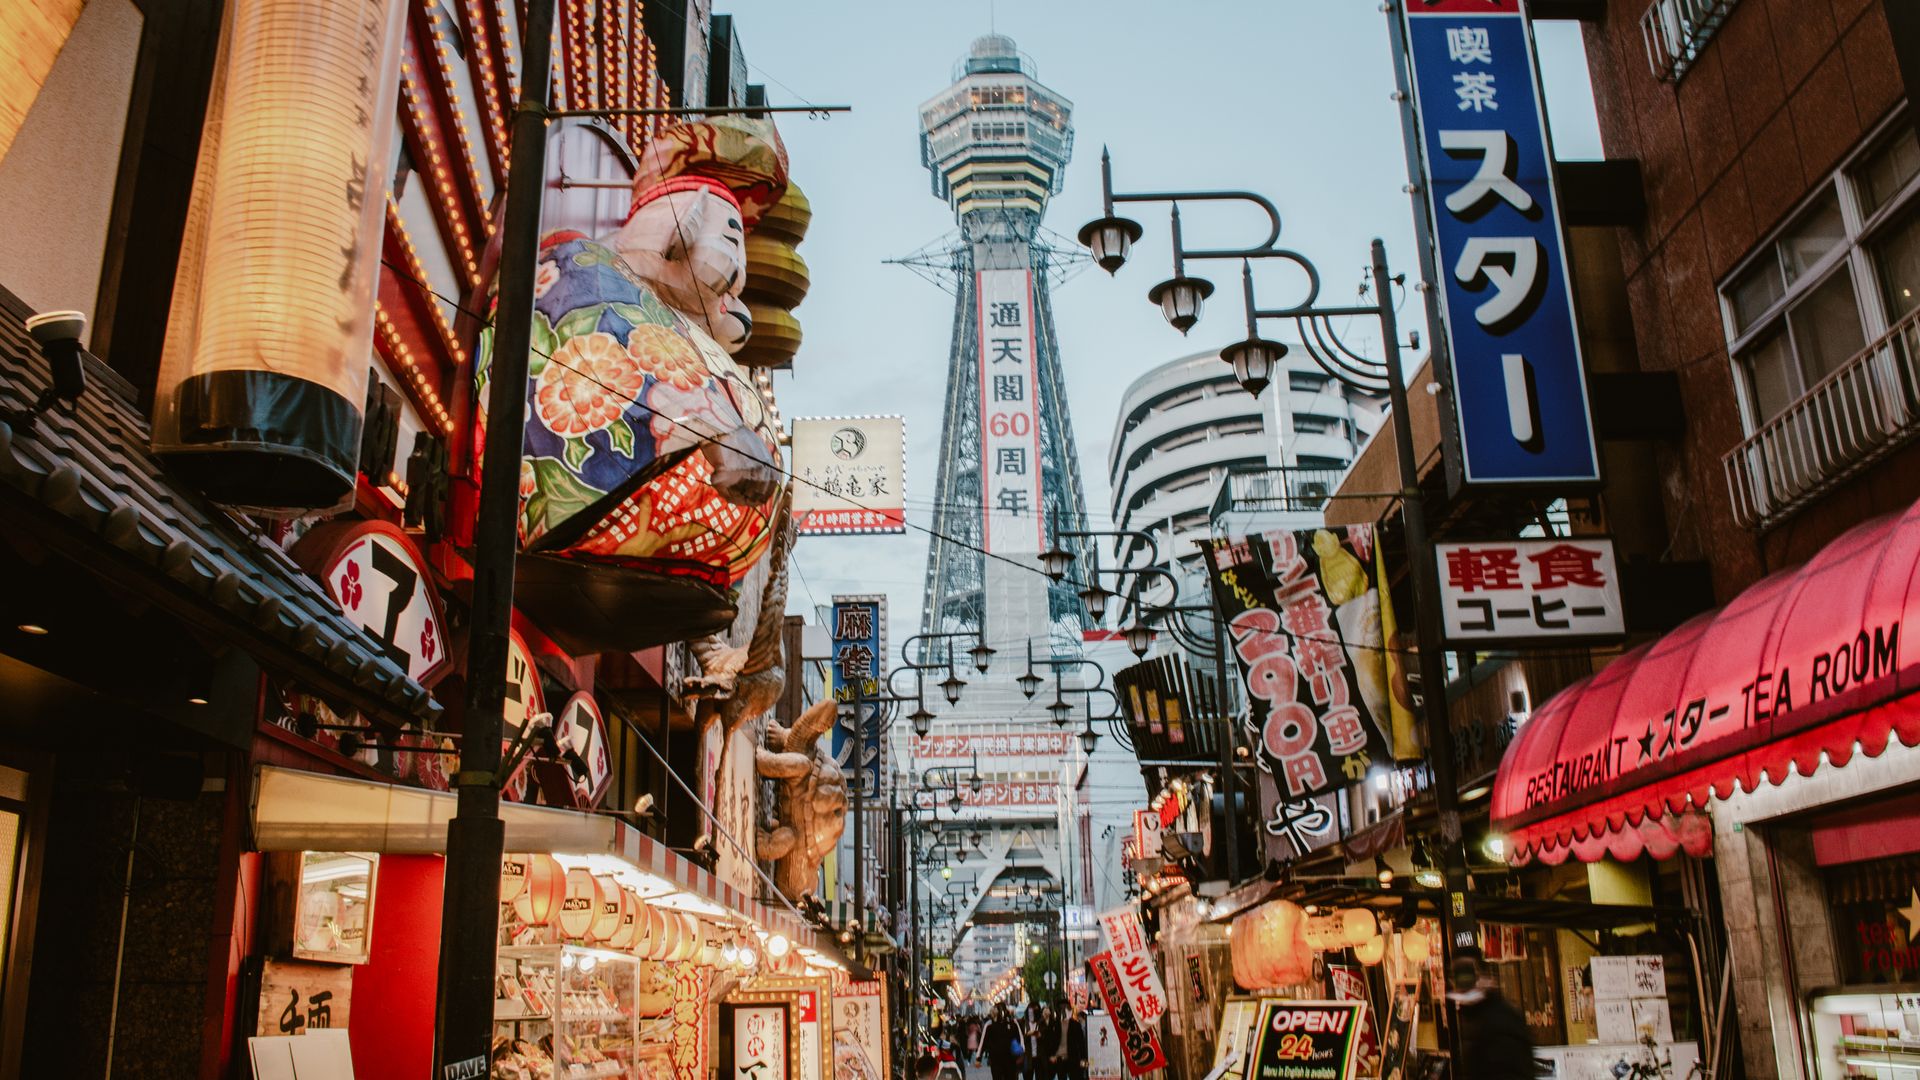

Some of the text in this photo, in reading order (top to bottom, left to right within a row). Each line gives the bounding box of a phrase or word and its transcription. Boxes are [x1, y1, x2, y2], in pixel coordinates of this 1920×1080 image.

[1438, 26, 1543, 447] 喫茶 スター
[989, 302, 1030, 519] 通天閣60周年
[1446, 544, 1607, 593] 軽食
[1457, 595, 1607, 632] コーヒー
[1229, 606, 1329, 797] 290円
[1525, 736, 1629, 812] RESTAURANT
[1742, 667, 1793, 731] TEA
[1810, 620, 1901, 705] ROOM
[1122, 955, 1165, 1022] どて焼
[1272, 1009, 1350, 1035] OPEN!
[1277, 1033, 1313, 1061] 24
[447, 1056, 488, 1080] DAVE
